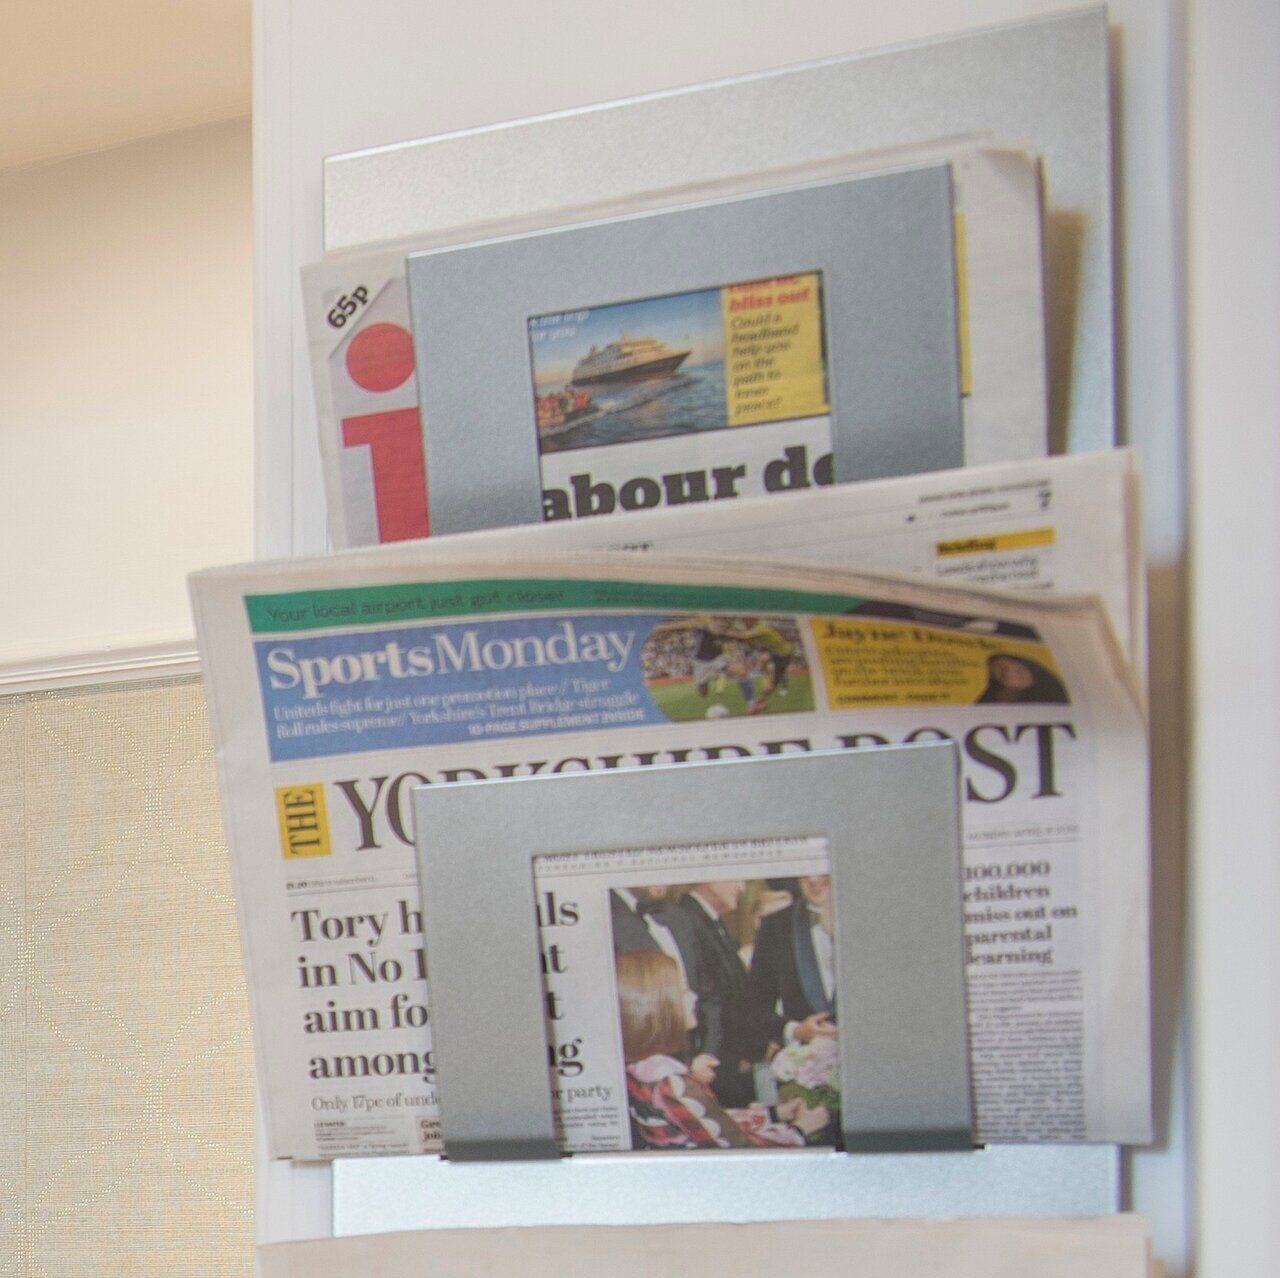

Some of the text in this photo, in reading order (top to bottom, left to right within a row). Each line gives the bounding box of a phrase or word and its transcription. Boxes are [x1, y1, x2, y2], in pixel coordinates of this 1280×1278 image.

[326, 284, 369, 329] 65p
[542, 464, 746, 522] abour
[267, 606, 306, 622] Your
[312, 600, 356, 619] local
[360, 594, 424, 615] airport
[266, 621, 637, 699] SportsMonday
[284, 789, 321, 855] THE
[290, 907, 389, 947] Tory
[1014, 904, 1046, 921] out
[1051, 906, 1078, 919] on
[964, 922, 1053, 949] parental
[297, 955, 338, 989] in
[347, 950, 403, 986] No
[303, 993, 429, 1034] aim fo
[310, 1094, 349, 1114] Only
[386, 1092, 403, 1107] of
[566, 1085, 613, 1103] party
